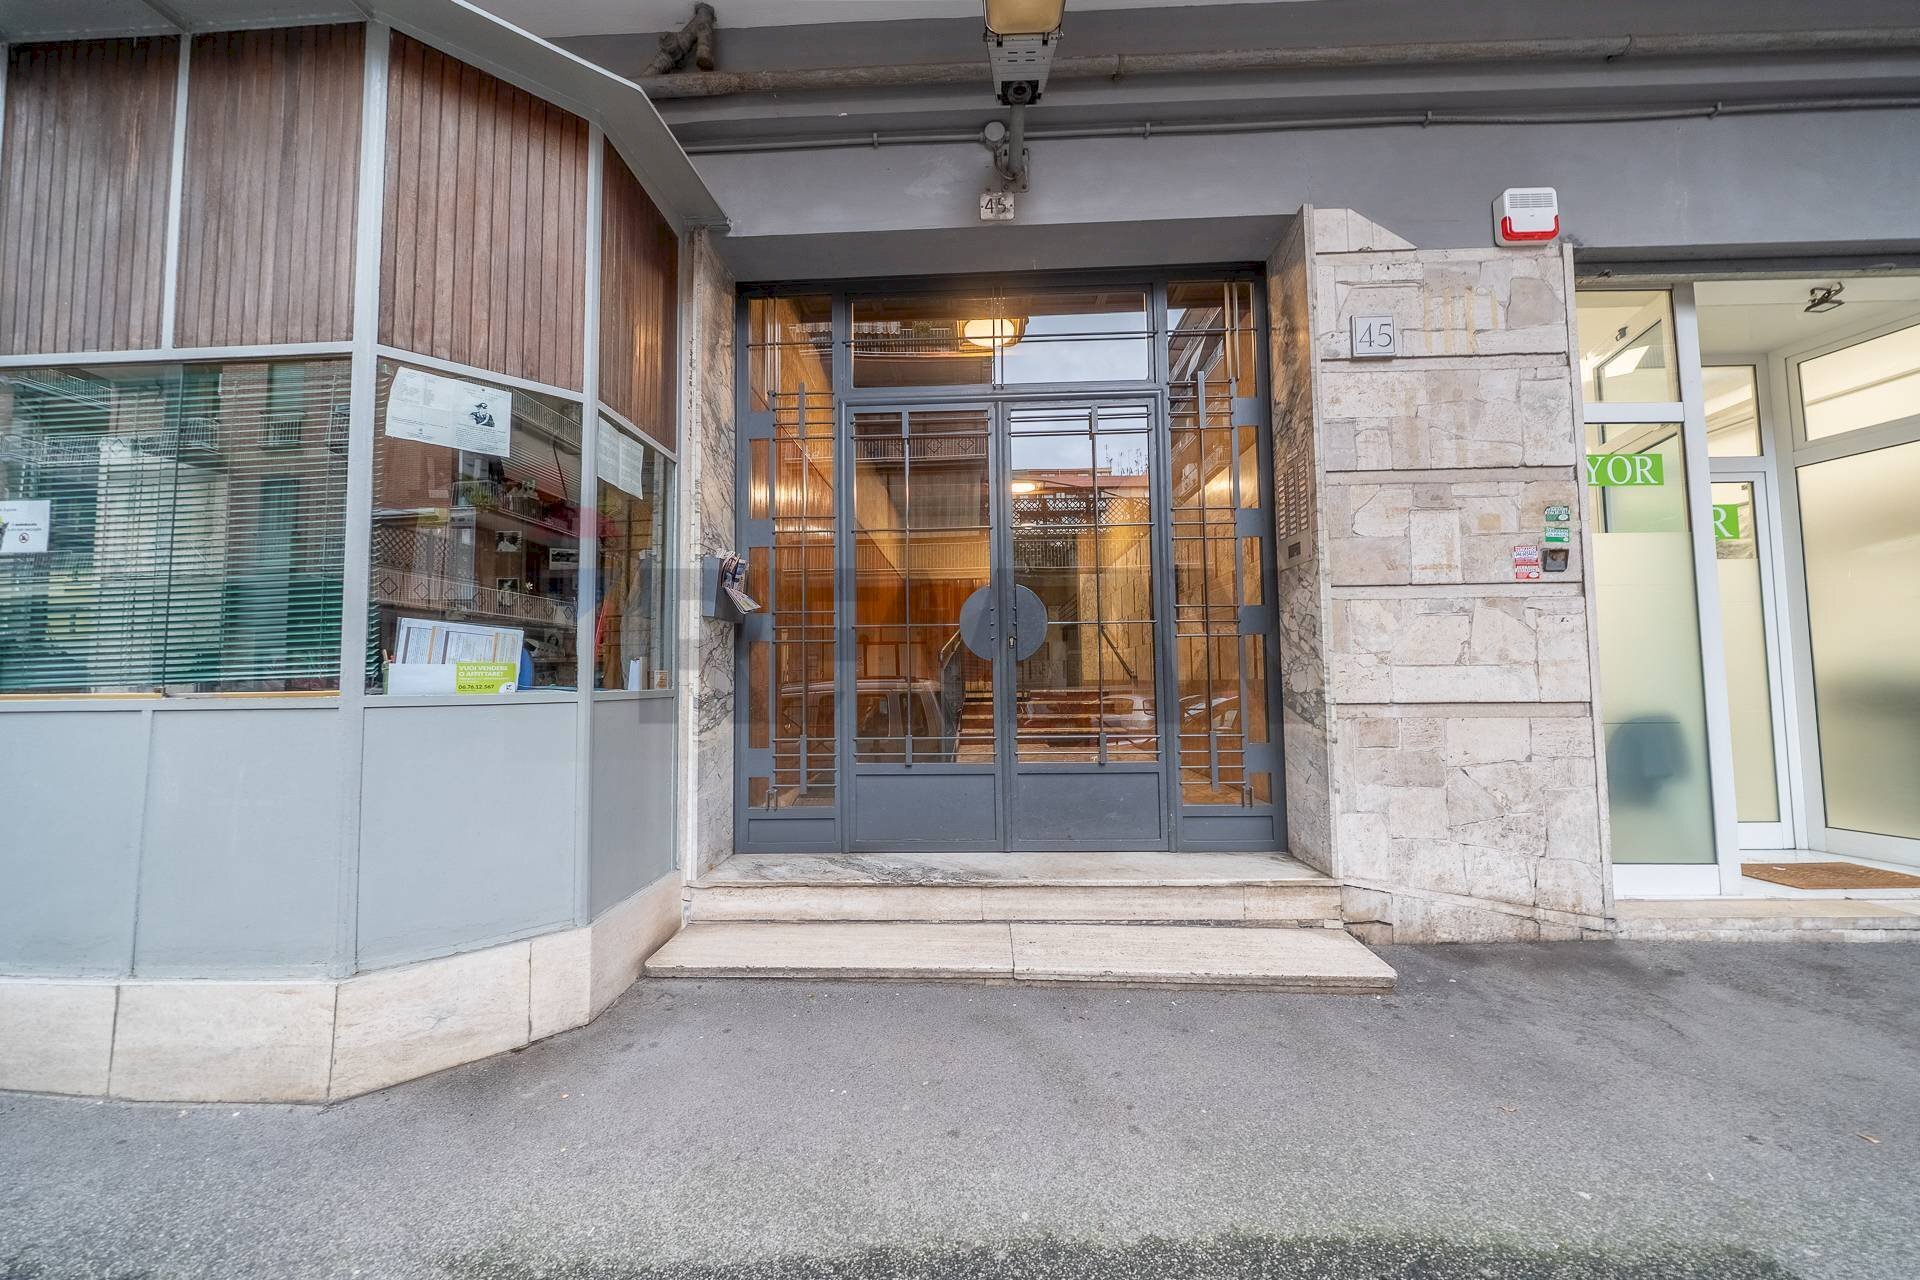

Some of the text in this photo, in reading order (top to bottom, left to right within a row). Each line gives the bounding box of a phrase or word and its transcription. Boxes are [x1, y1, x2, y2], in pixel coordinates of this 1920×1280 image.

[984, 197, 1007, 215] 45
[1358, 322, 1393, 348] 45
[1585, 455, 1660, 485] YOR
[1712, 506, 1734, 538] R
